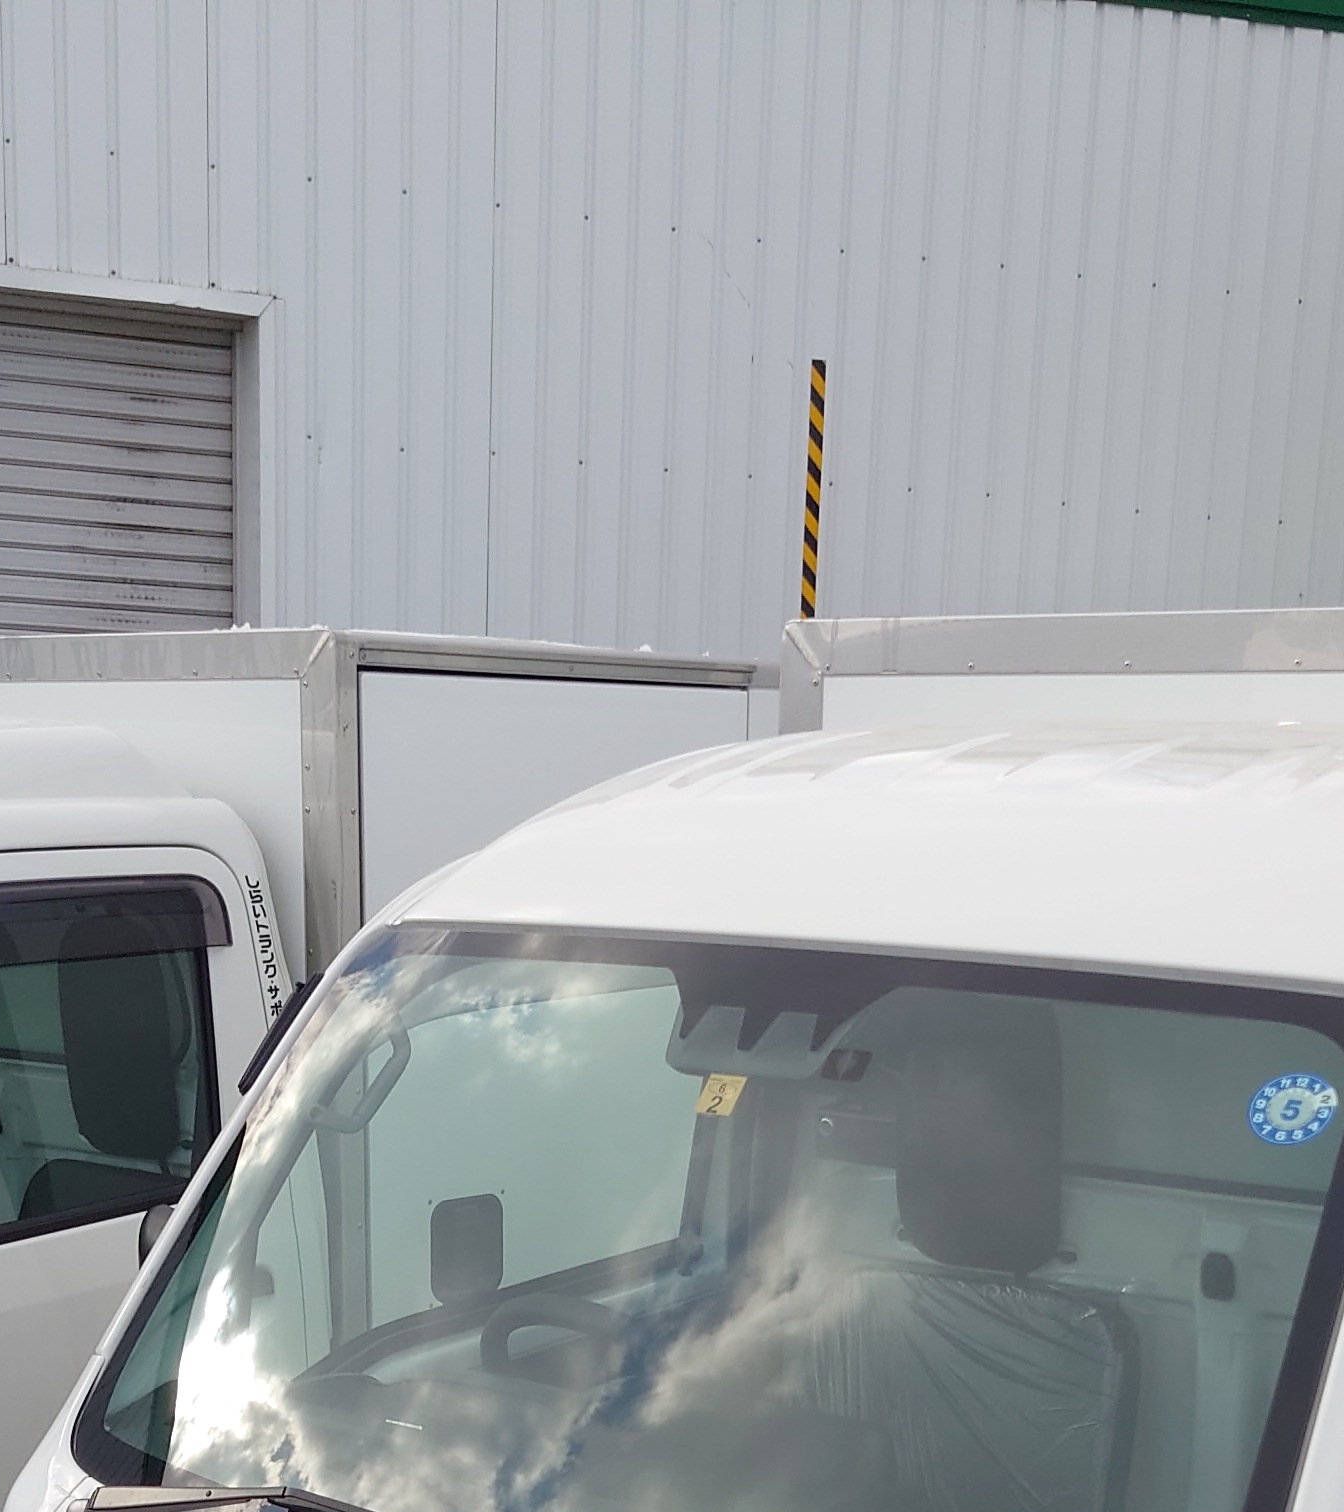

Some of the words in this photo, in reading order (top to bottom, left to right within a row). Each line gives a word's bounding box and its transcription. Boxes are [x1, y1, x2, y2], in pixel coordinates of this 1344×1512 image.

[1280, 1079, 1291, 1088] 11
[1296, 1078, 1309, 1087] 12
[1264, 1087, 1275, 1097] 10
[1313, 1084, 1321, 1093] 1
[1319, 1095, 1331, 1104] 2
[706, 1096, 722, 1113] 2
[1255, 1100, 1266, 1109] 9
[1280, 1100, 1303, 1120] 5
[1317, 1110, 1329, 1118] 3
[1253, 1114, 1263, 1123] 8
[1262, 1125, 1272, 1134] 7
[1308, 1122, 1319, 1131] 4
[1275, 1131, 1286, 1140] 6
[1292, 1130, 1303, 1140] 5
